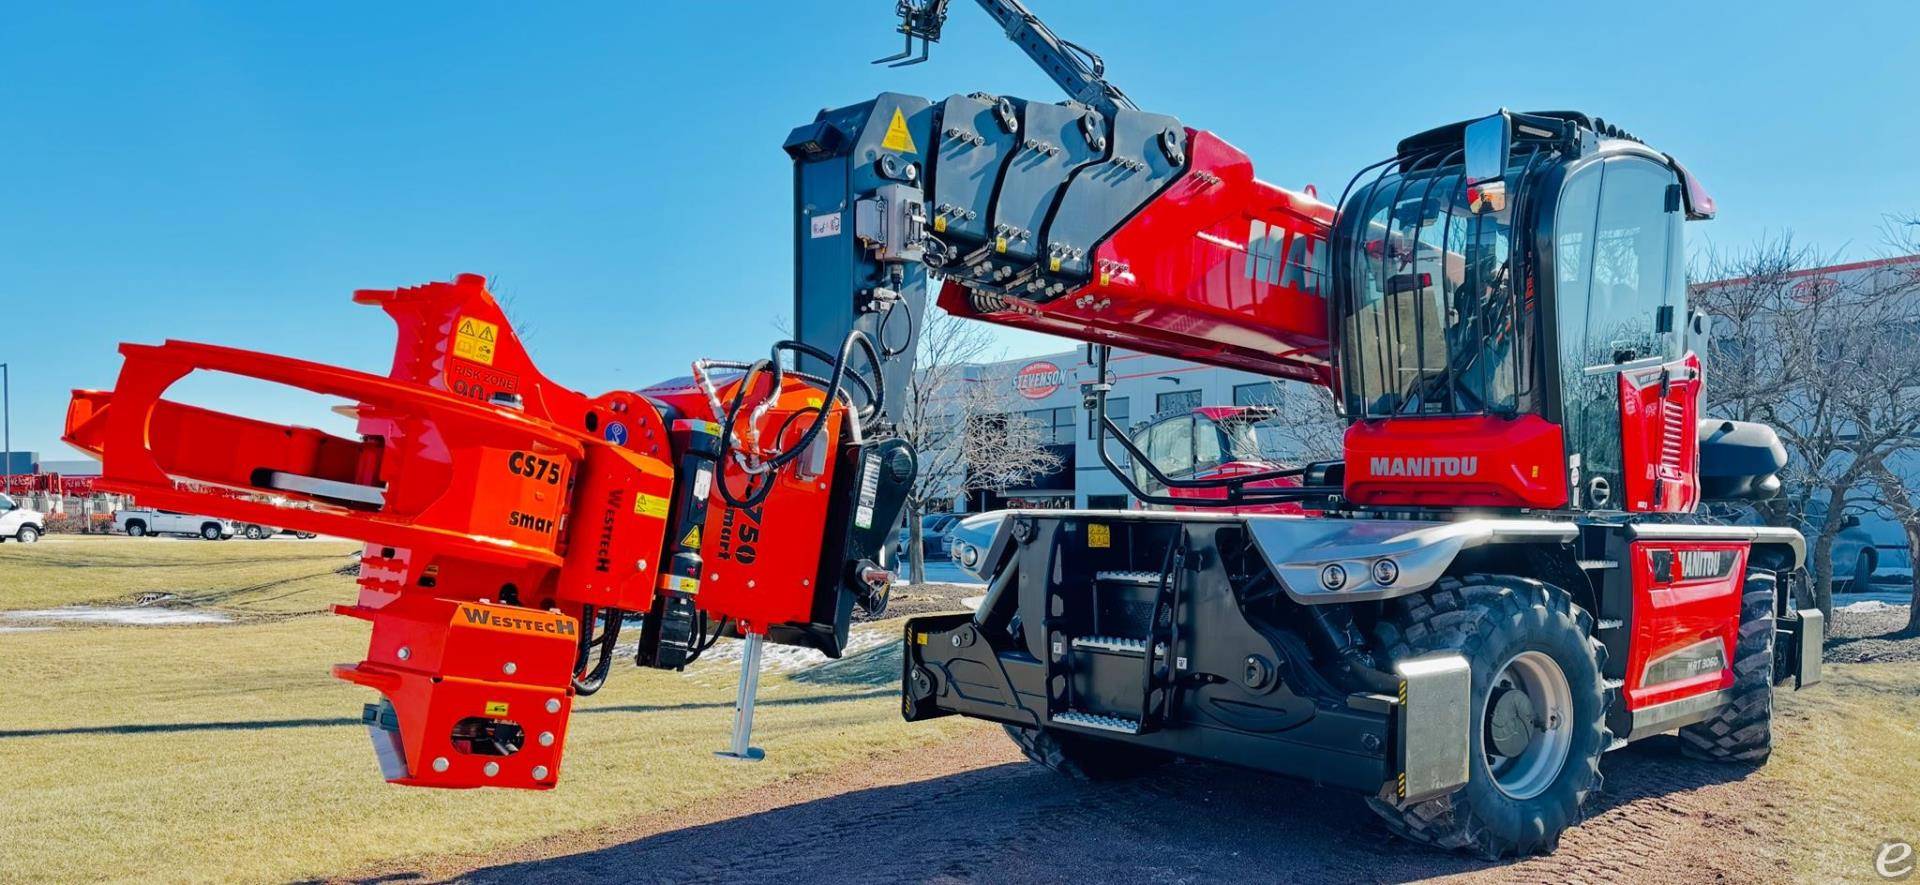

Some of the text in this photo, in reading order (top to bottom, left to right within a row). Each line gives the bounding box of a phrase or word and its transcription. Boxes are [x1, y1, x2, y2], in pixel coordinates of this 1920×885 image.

[455, 365, 513, 390] RISK ZONE
[1012, 369, 1068, 391] STEVENSON
[1369, 456, 1478, 477] MANITOU
[718, 503, 736, 560] mart
